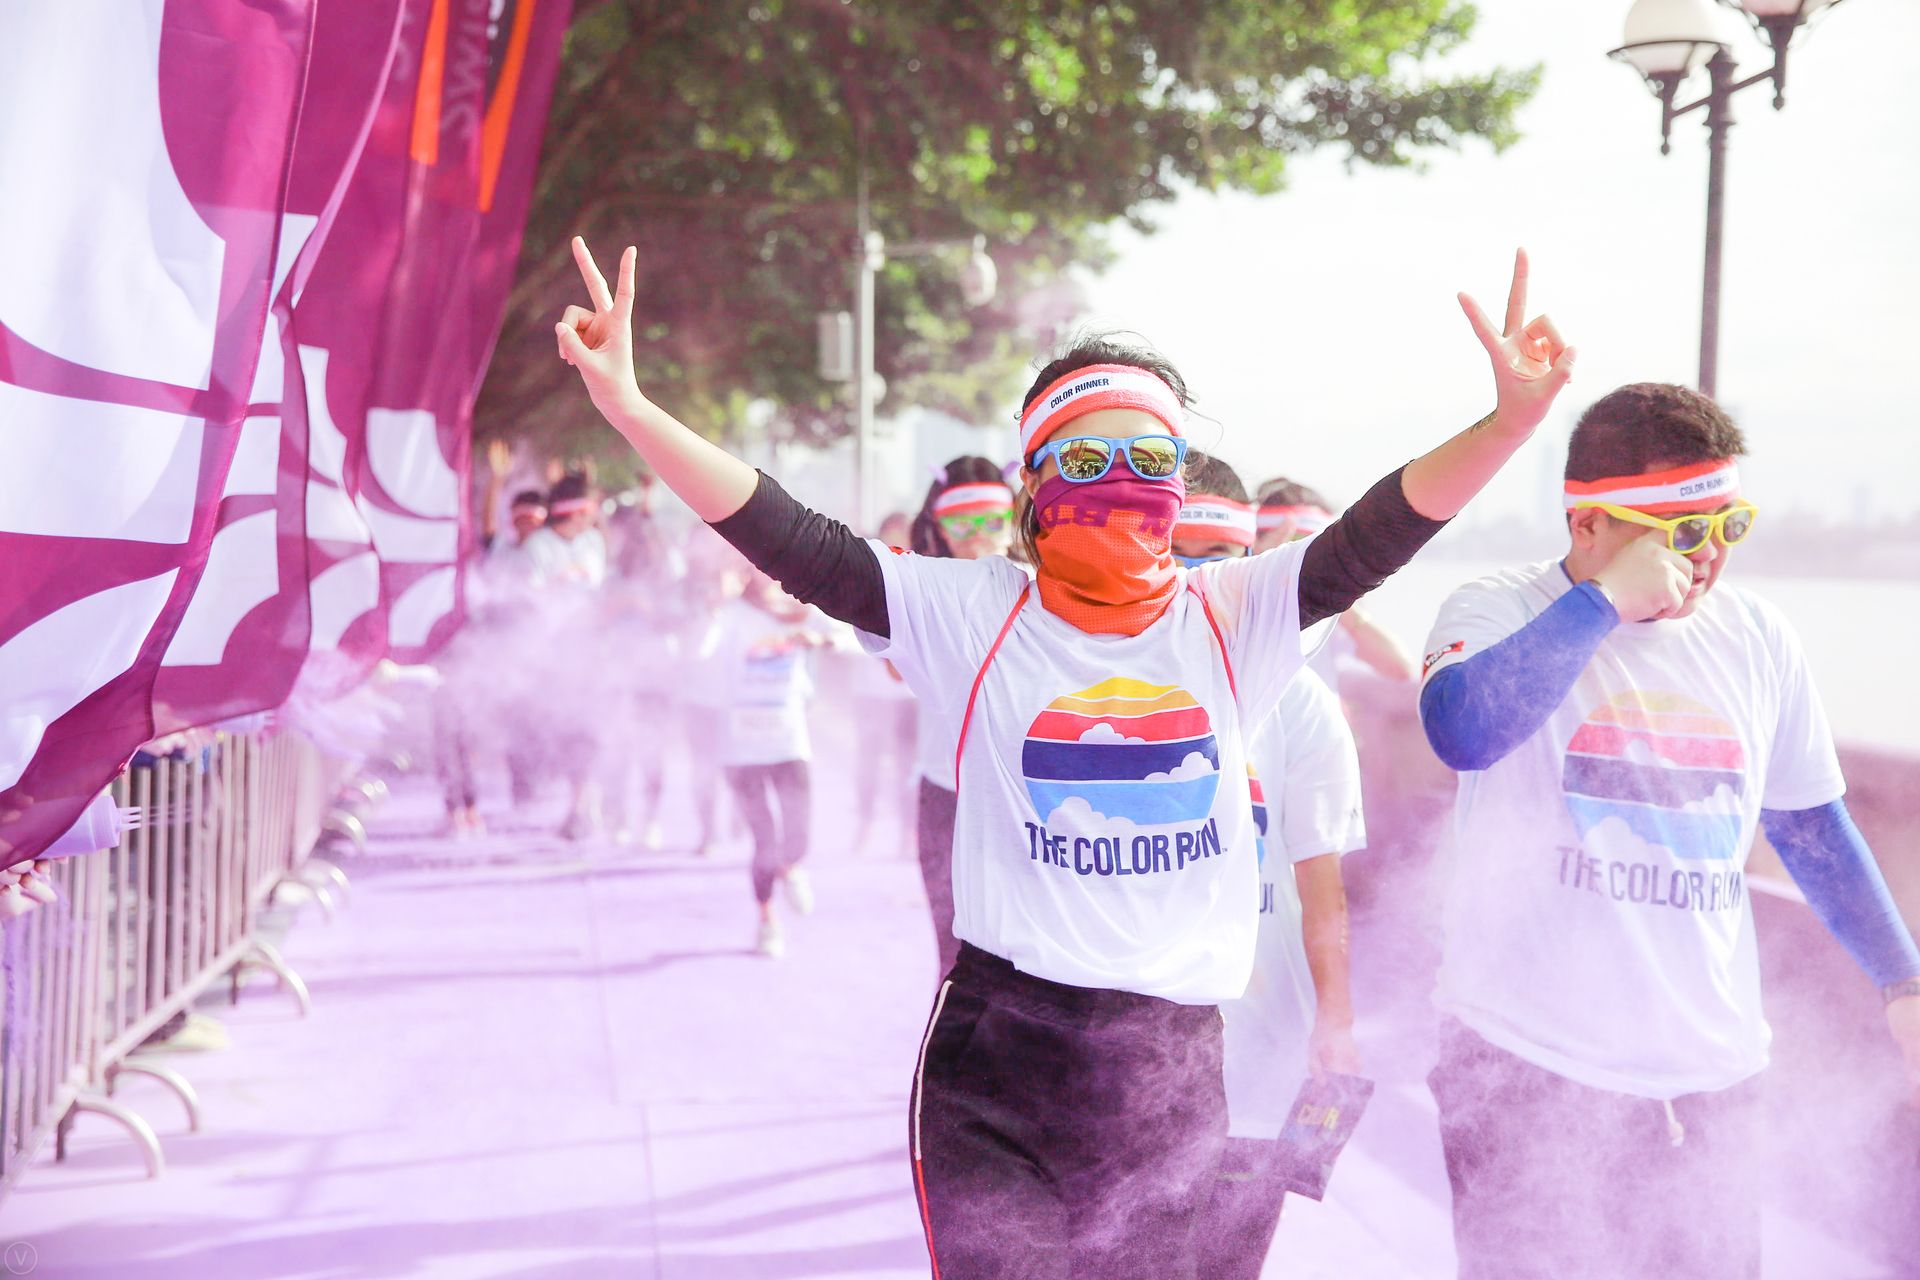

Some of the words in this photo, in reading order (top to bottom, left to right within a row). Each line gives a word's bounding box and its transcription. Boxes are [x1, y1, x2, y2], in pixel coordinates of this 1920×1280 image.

[1050, 388, 1074, 409] COLOR
[1074, 378, 1110, 394] RUNNER
[1680, 482, 1706, 497] COLOR
[1025, 821, 1070, 868] THE
[1074, 834, 1172, 876] COLOR
[1556, 845, 1602, 896] THE
[1608, 860, 1704, 911] COLOR
